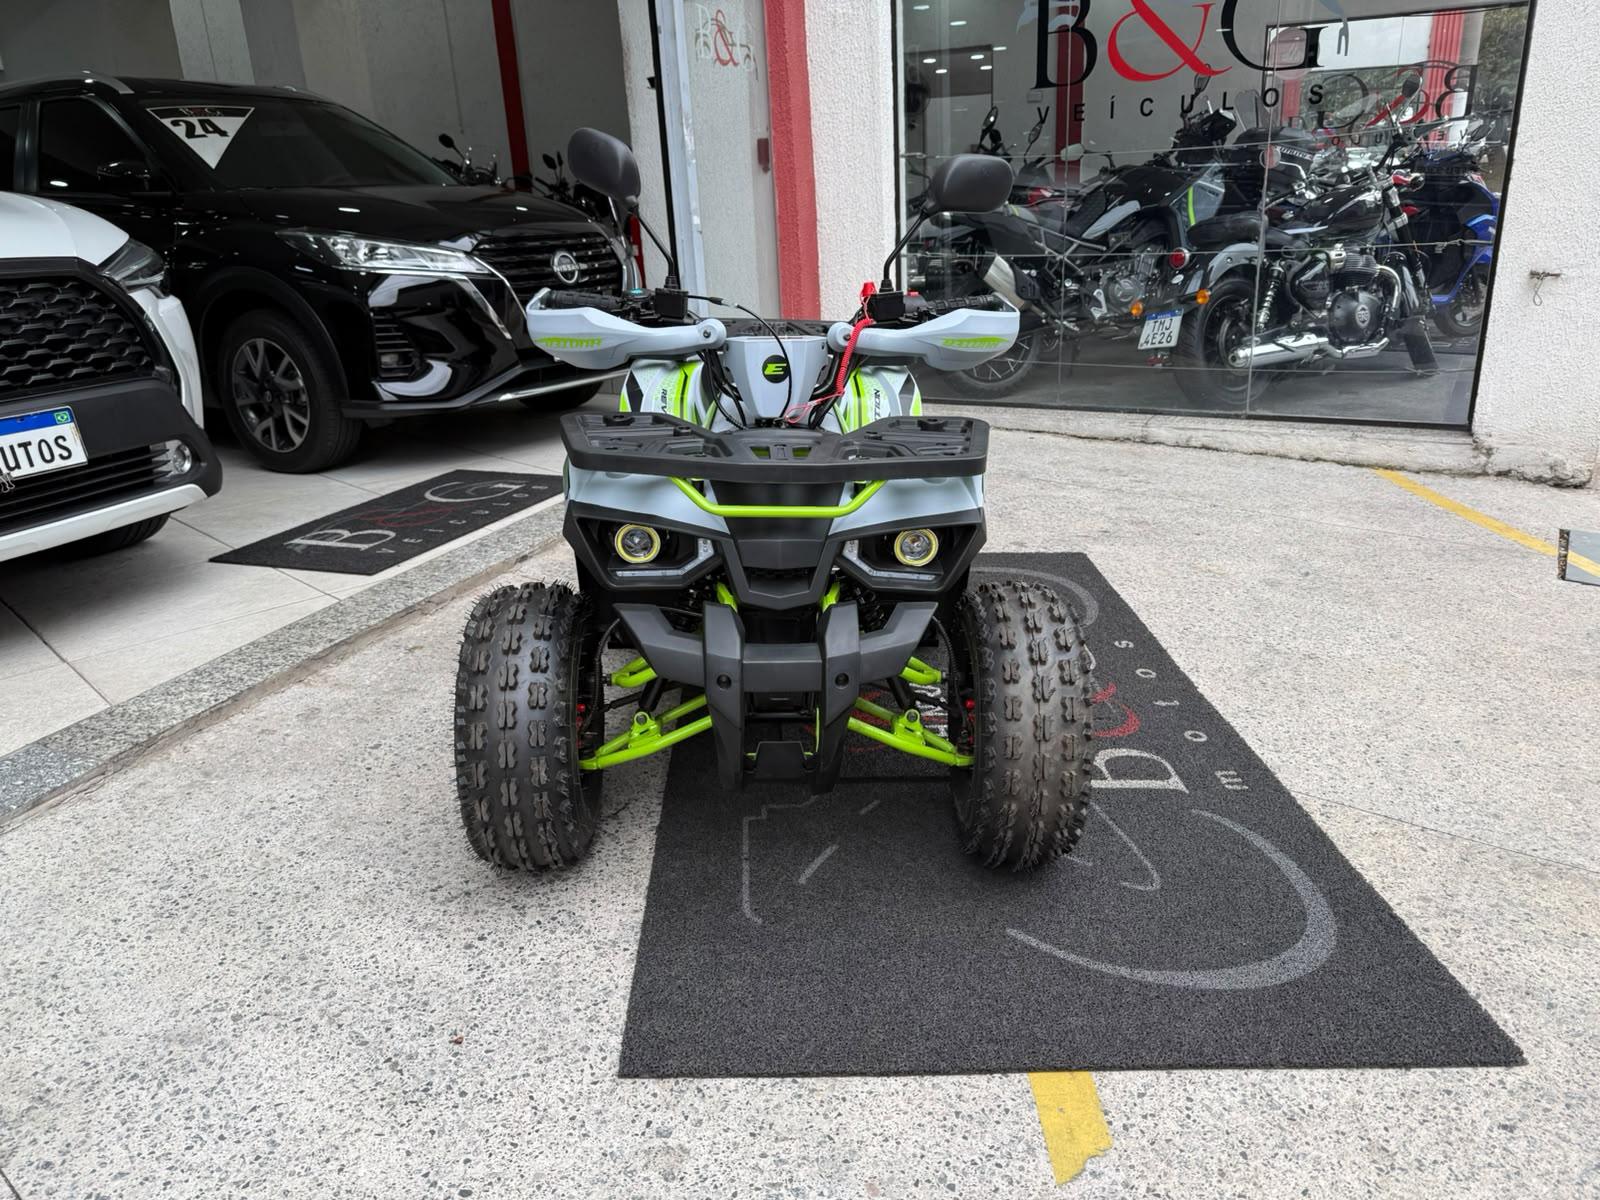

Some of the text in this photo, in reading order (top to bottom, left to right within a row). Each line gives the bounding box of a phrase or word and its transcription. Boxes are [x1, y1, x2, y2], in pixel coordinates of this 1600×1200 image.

[1036, 83, 1326, 124] VEÍCULOS
[170, 117, 230, 140] 24
[1151, 317, 1173, 333] TMJ
[1143, 330, 1173, 347] 4E26
[0, 434, 73, 474] UTOS
